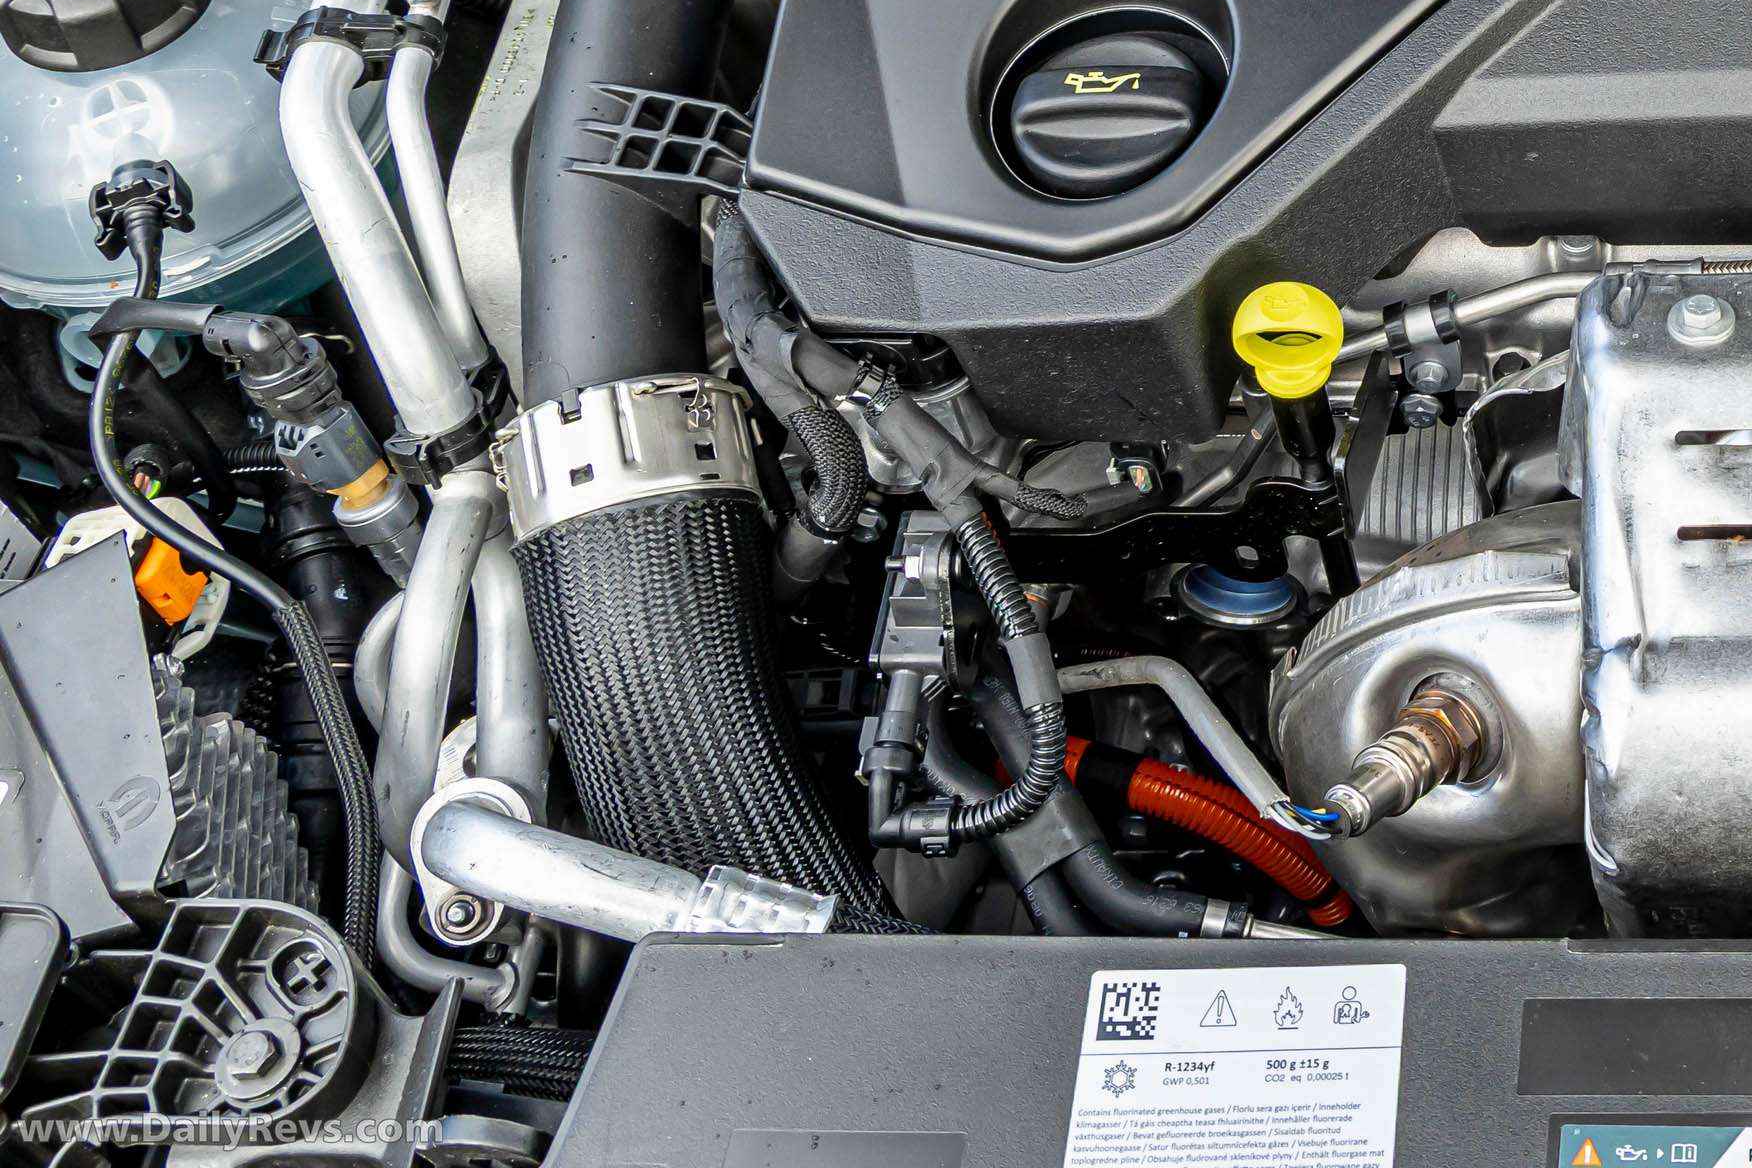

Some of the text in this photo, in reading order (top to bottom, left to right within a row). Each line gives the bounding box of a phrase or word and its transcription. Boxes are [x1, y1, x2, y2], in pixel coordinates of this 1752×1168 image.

[1165, 1061, 1215, 1073] R-1234yf
[1266, 1059, 1329, 1071] 500 g ±15 g
[1186, 1077, 1209, 1087] 0,501
[1265, 1074, 1286, 1082] CO2
[1291, 1075, 1302, 1083] eq
[1307, 1073, 1343, 1082] 0,00025
[1078, 1109, 1111, 1117] Contains
[1114, 1108, 1155, 1116] fluorinated
[1157, 1107, 1202, 1117] greenhouse
[1204, 1107, 1225, 1115] gases
[1319, 1102, 1361, 1111] Inneholder
[1076, 1121, 1121, 1130] klimagasser
[1157, 1119, 1193, 1128] cheaptha
[1313, 1114, 1353, 1122] fluorerade
[1133, 1132, 1154, 1140] Bevat
[1156, 1131, 1206, 1140] gefluoreerde
[1208, 1130, 1266, 1138] broeikasgassen
[1274, 1127, 1305, 1136] Sisaldab
[1307, 1126, 1342, 1134] fluoritud
[1073, 1144, 1141, 1153] kasvuhoonegaase
[1148, 1143, 1169, 1151] Satur
[1298, 1139, 1327, 1148] Vsebuje
[1330, 1137, 1368, 1146] fluorirane
[1071, 1156, 1119, 1165] toplogredne
[1147, 1155, 1184, 1163] Obsahuje
[1331, 1150, 1367, 1159] fluorgase
